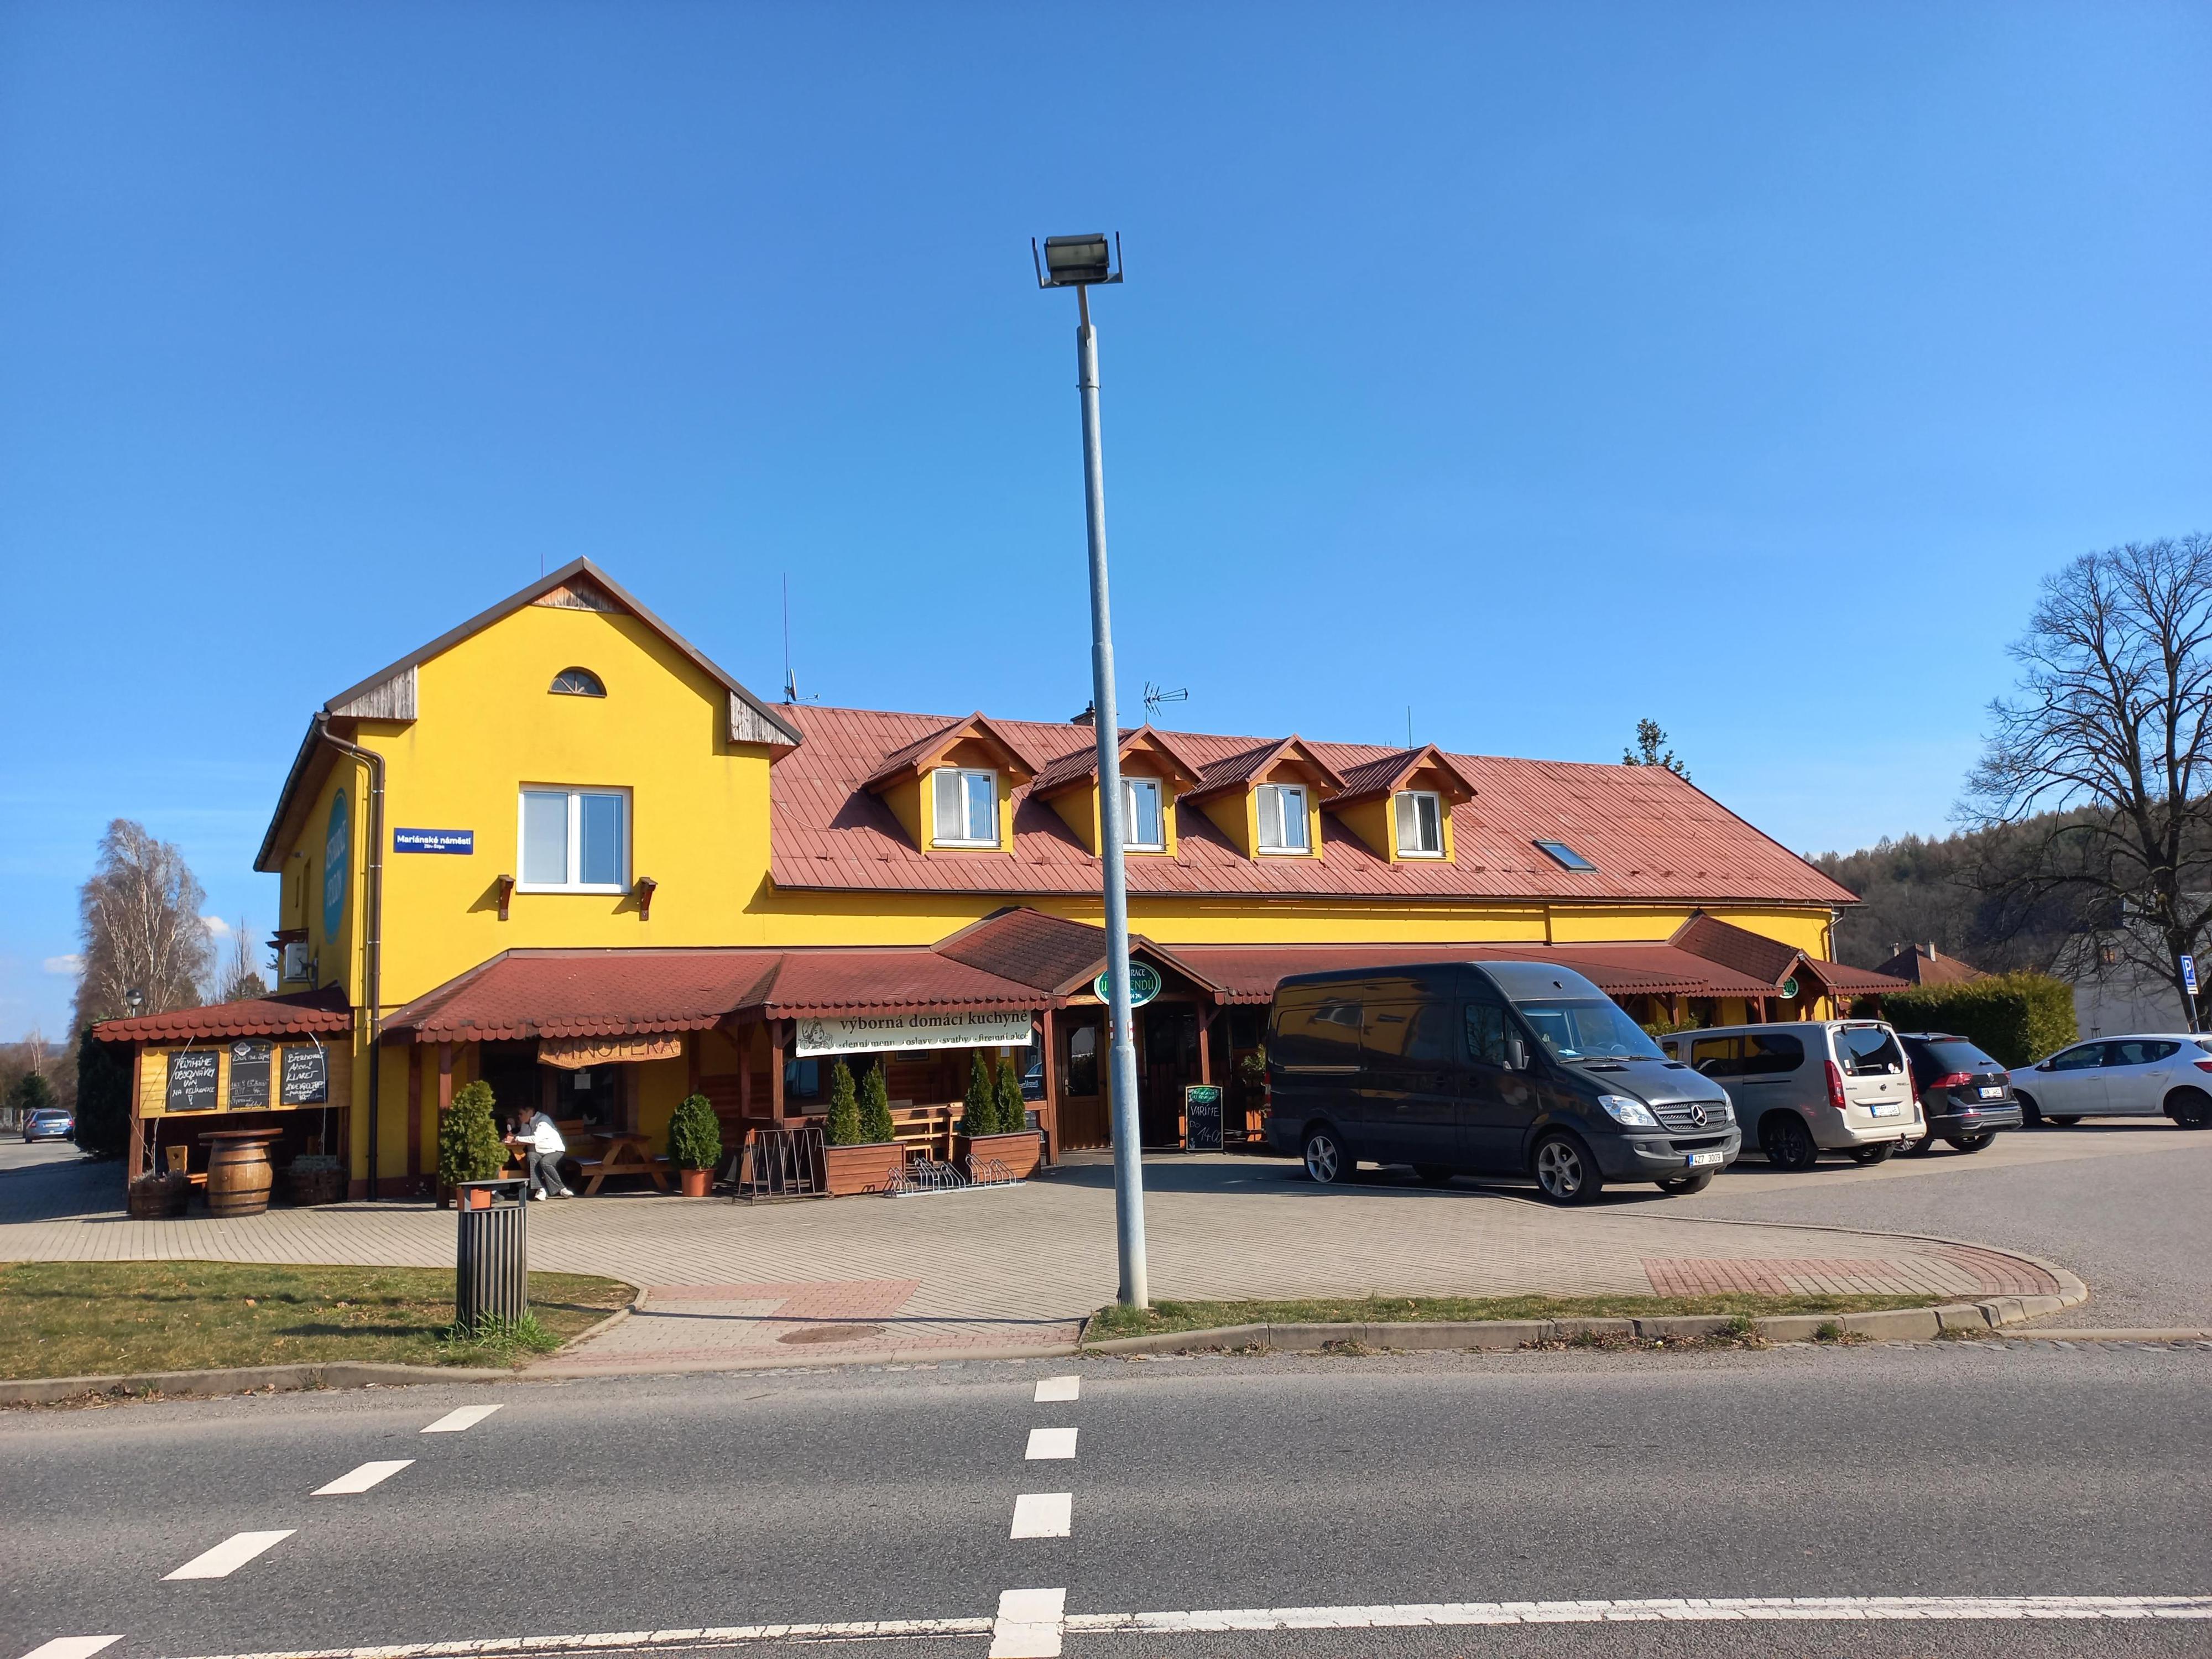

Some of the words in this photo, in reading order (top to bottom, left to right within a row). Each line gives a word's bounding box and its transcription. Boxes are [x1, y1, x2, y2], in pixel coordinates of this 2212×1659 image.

[397, 835, 439, 844] Mariánské
[440, 837, 471, 845] náměstí
[1130, 977, 1154, 990] ENDŮ
[840, 1014, 904, 1034] výborná
[909, 1013, 963, 1027] domácí
[545, 1035, 676, 1060] VINOTEKA
[1695, 1155, 1704, 1164] 4Z7
[1708, 1153, 1721, 1162] 3009
